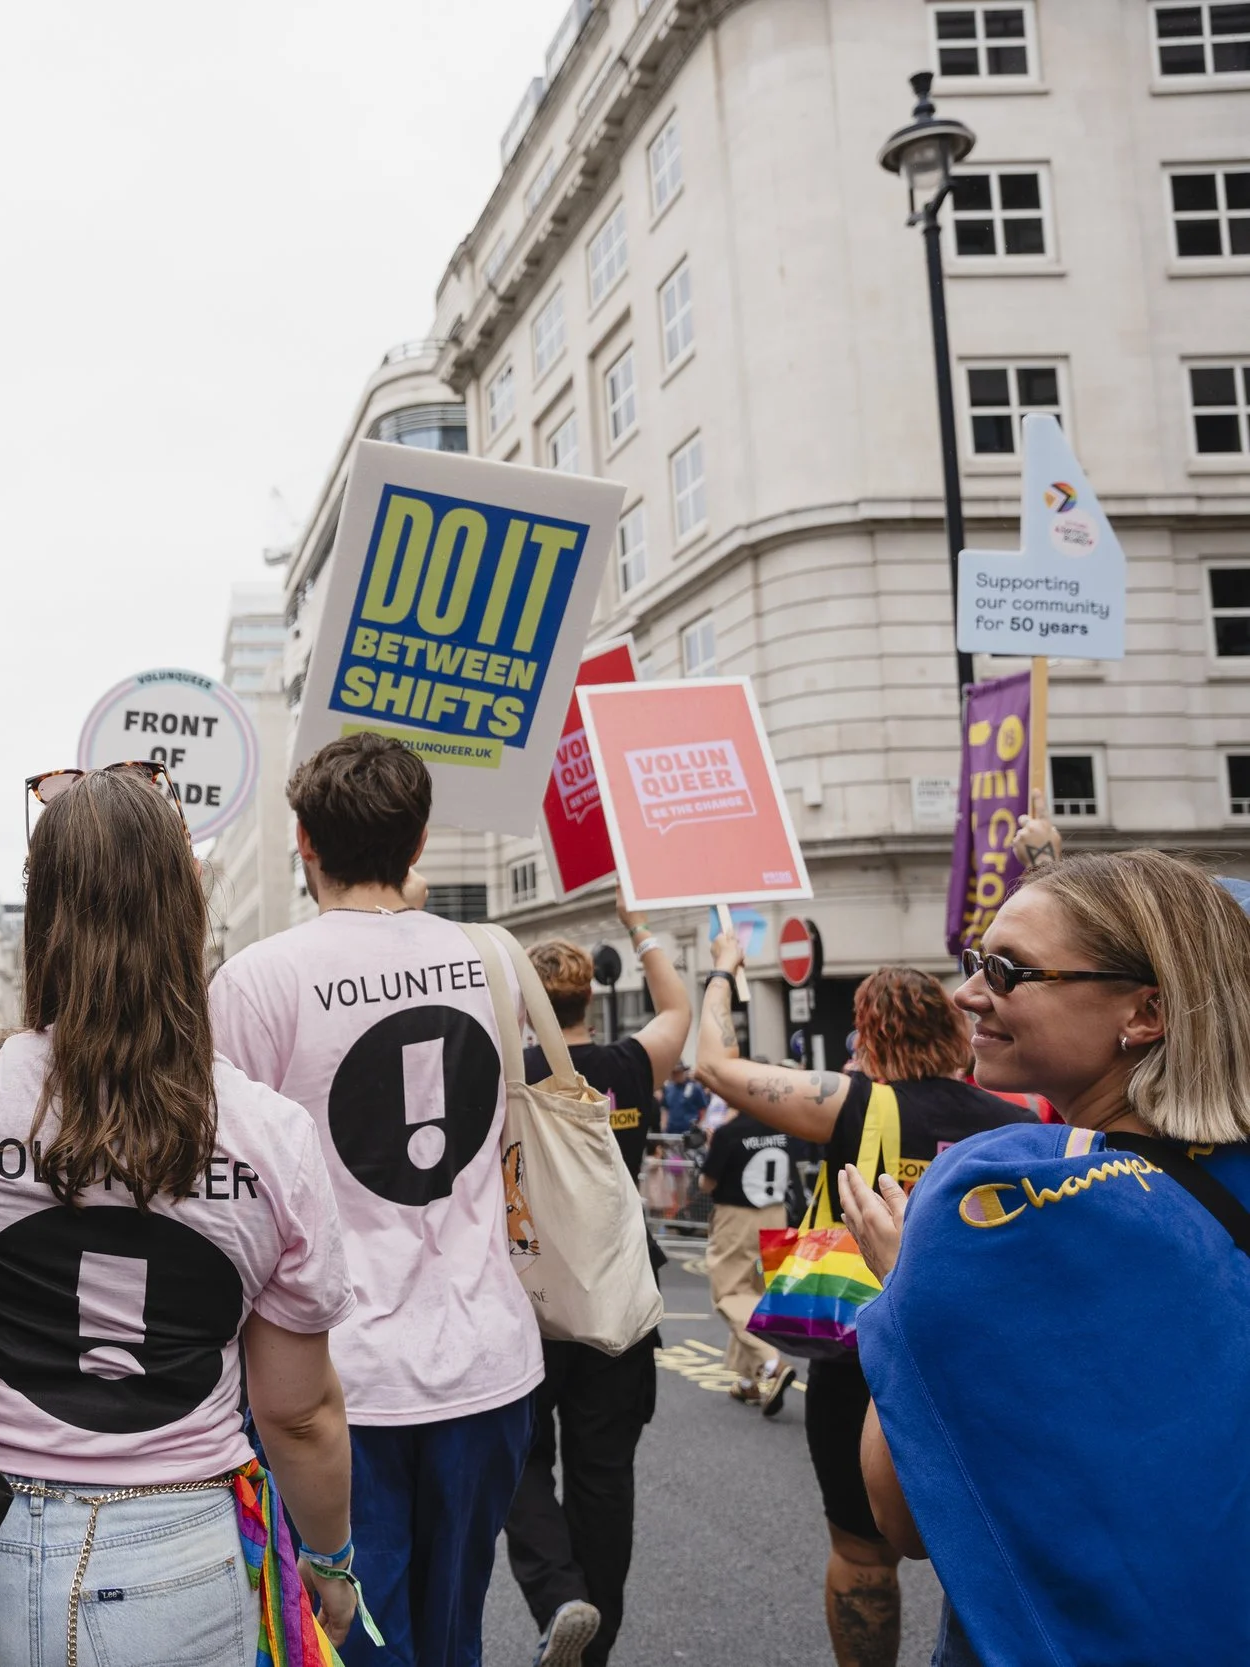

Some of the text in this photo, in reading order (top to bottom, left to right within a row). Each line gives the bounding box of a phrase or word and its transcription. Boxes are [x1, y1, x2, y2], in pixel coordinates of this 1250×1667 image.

[360, 494, 579, 653] DO IT
[975, 572, 1080, 596] Supporting
[975, 597, 1110, 619] our community
[975, 615, 1088, 637] for 50 years
[351, 626, 537, 692] BETWEEN
[138, 671, 213, 690] VOLUNQUEER
[340, 666, 525, 738] SHIFTS
[124, 710, 219, 738] FRONT
[150, 746, 186, 769] OF
[398, 740, 492, 758] OLUNQUEER.UK
[635, 747, 729, 775] VOLUN
[641, 769, 736, 798] QUEER
[651, 795, 744, 819] BE THE CHANGE
[314, 959, 489, 1011] VOLUNTEE
[103, 1591, 118, 1599] Lee
